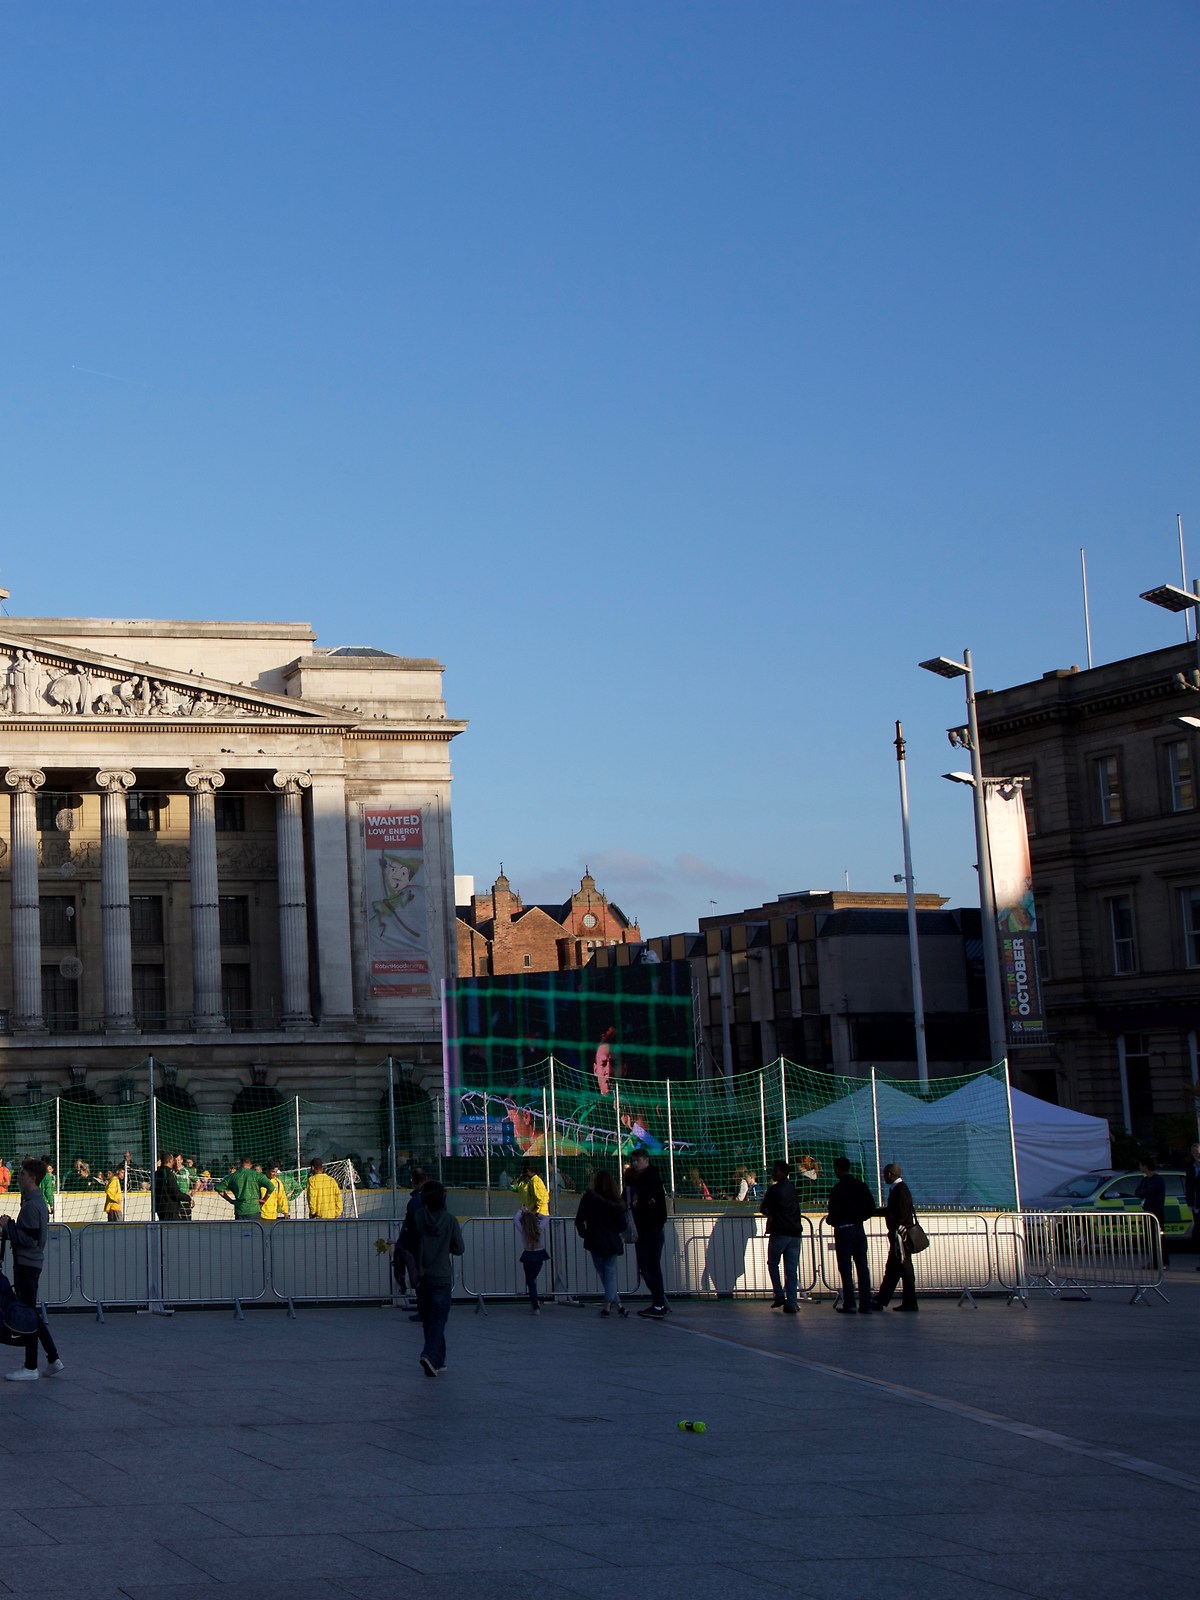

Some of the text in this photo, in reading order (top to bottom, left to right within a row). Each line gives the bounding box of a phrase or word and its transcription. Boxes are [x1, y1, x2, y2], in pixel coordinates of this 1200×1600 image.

[367, 814, 420, 826] WANTED
[388, 827, 420, 835] ENERGY
[1003, 939, 1018, 1016] NOTTINGHAM
[1012, 938, 1031, 1016] OCTOBER
